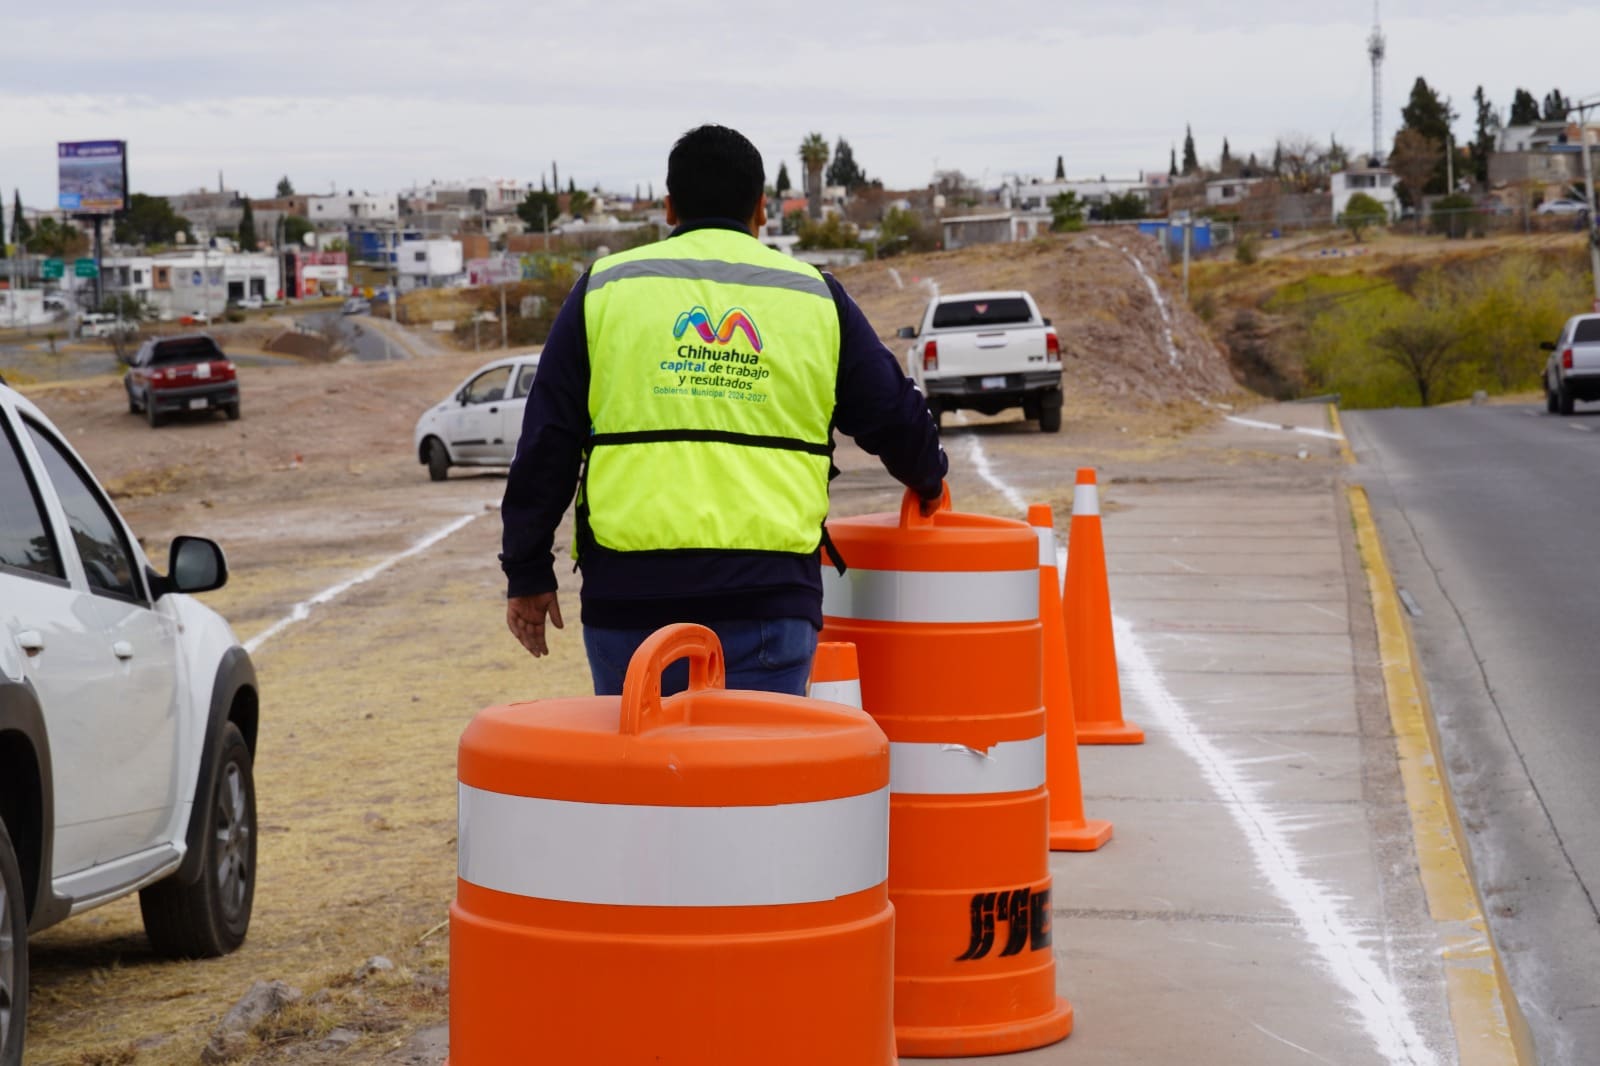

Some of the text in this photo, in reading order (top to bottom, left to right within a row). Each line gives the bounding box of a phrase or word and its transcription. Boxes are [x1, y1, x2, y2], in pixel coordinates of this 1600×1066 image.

[677, 345, 759, 364] Chihuahua
[660, 360, 769, 380] capital de trabajo
[678, 375, 753, 390] y resultados
[653, 386, 688, 395] Gobierno
[691, 387, 725, 399] Municipal
